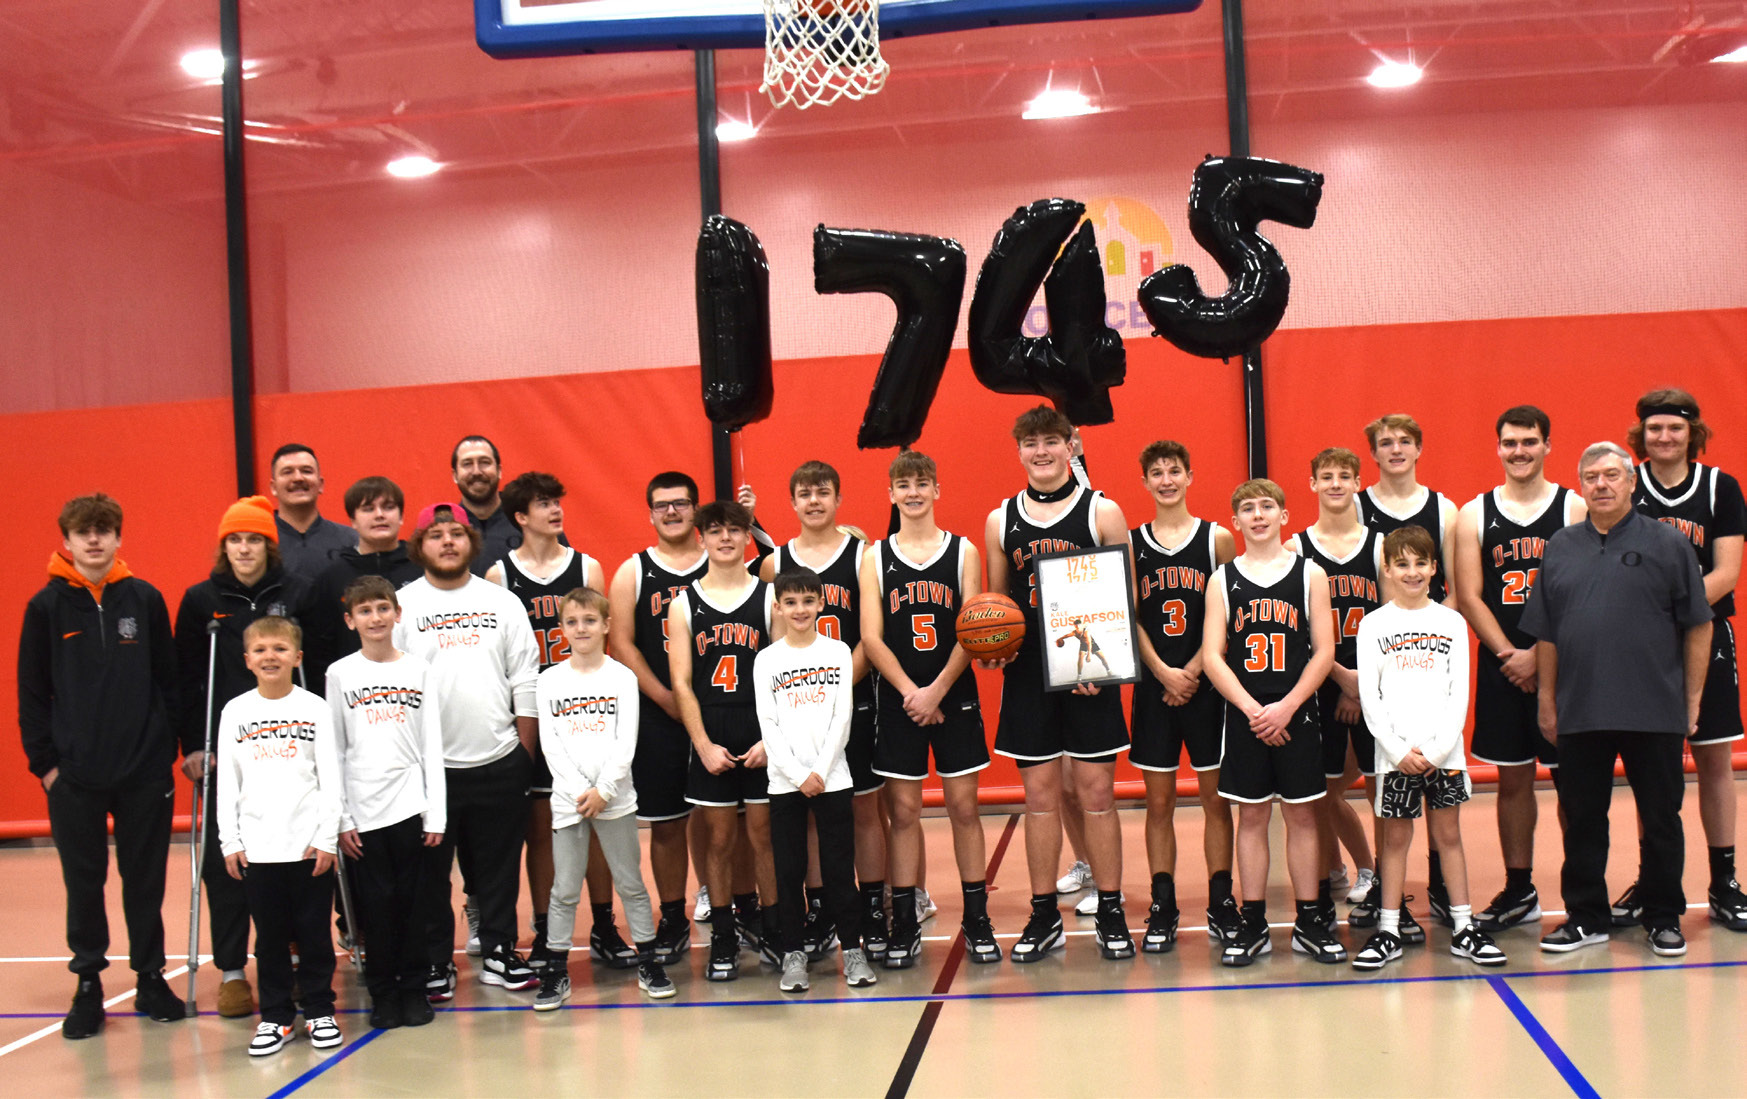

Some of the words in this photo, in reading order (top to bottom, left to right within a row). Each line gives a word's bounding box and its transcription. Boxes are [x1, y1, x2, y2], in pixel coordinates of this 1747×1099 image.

[1492, 537, 1549, 567] O-TOW
[889, 580, 953, 615] O-TOWN
[1141, 566, 1205, 600] O-TOWN
[417, 612, 498, 632] UNDERDOGS
[1050, 610, 1125, 628] GUSTAFSON
[1162, 599, 1187, 637] 3
[1234, 599, 1298, 632] O-TOWN
[696, 623, 760, 656] O-TOWN
[911, 614, 937, 651] 5
[1377, 632, 1453, 655] UNDERDOGS
[1244, 633, 1286, 673] 31
[711, 655, 738, 692] 4
[344, 686, 423, 709] UNDERDOGS
[235, 720, 315, 743] UNDERDOGS
